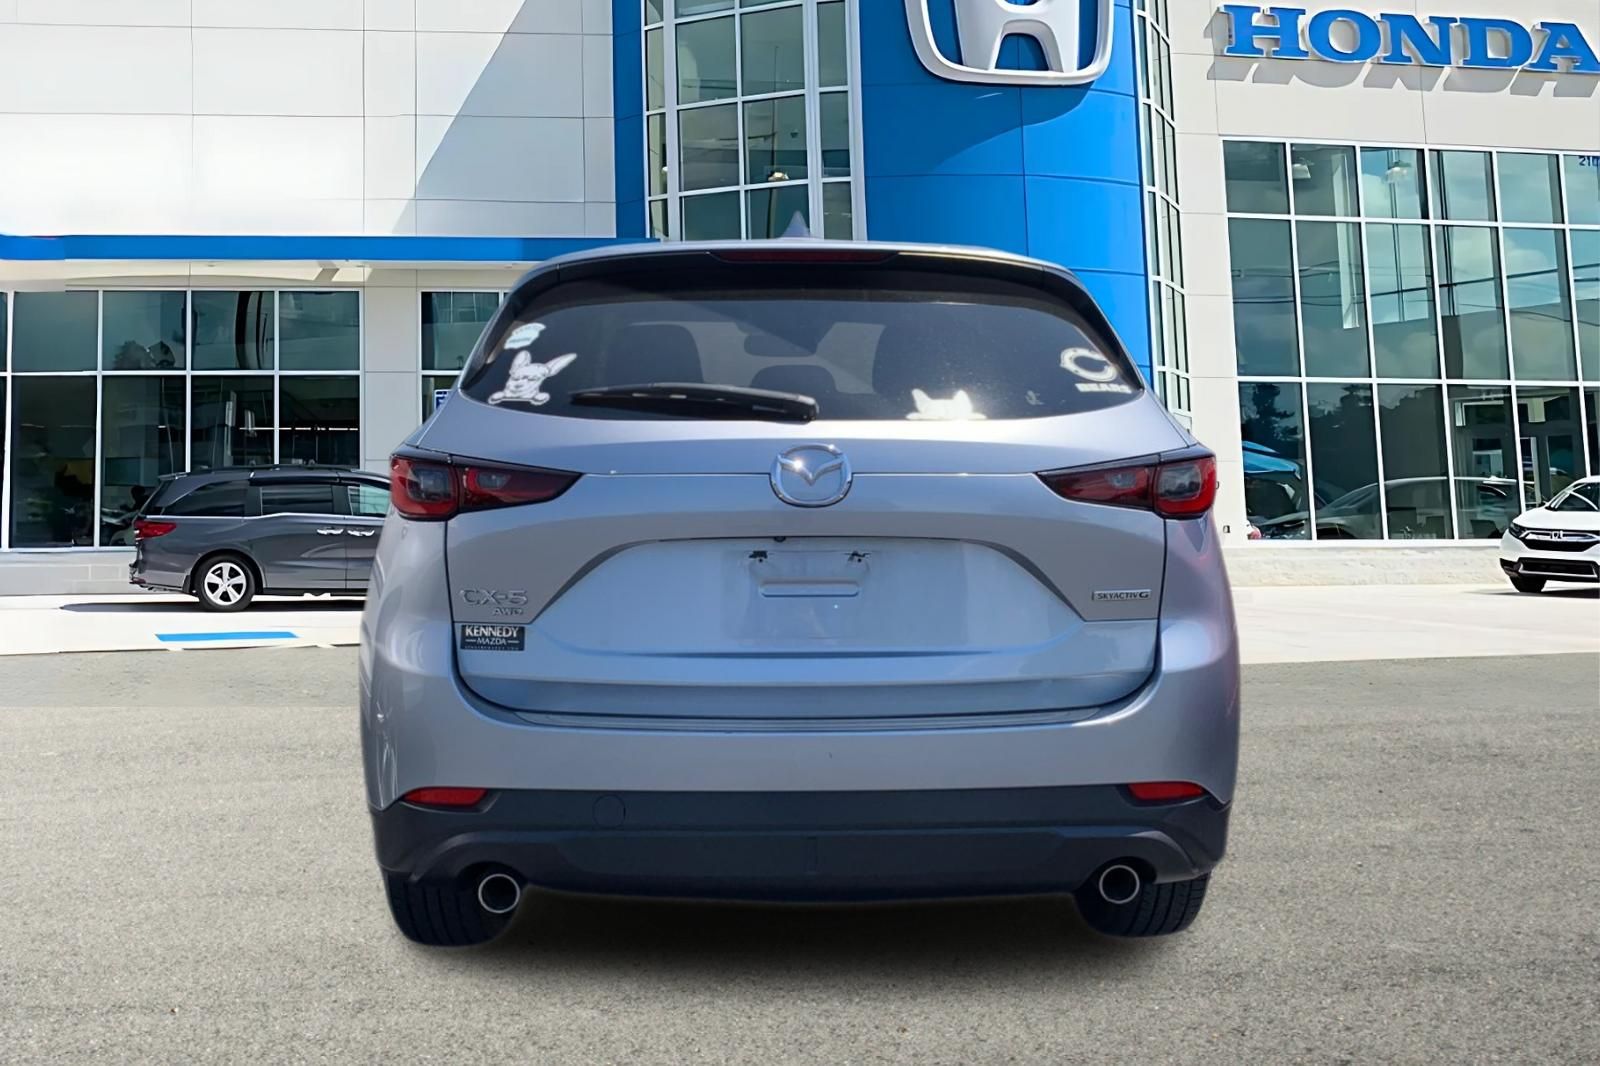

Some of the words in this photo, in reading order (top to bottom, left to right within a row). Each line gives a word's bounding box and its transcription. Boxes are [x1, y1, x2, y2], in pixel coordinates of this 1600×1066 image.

[1222, 4, 1600, 74] HONDA
[460, 589, 528, 606] CX-5
[493, 607, 524, 616] AWD
[465, 626, 519, 637] KENNEDY
[477, 637, 507, 645] MAZDA
